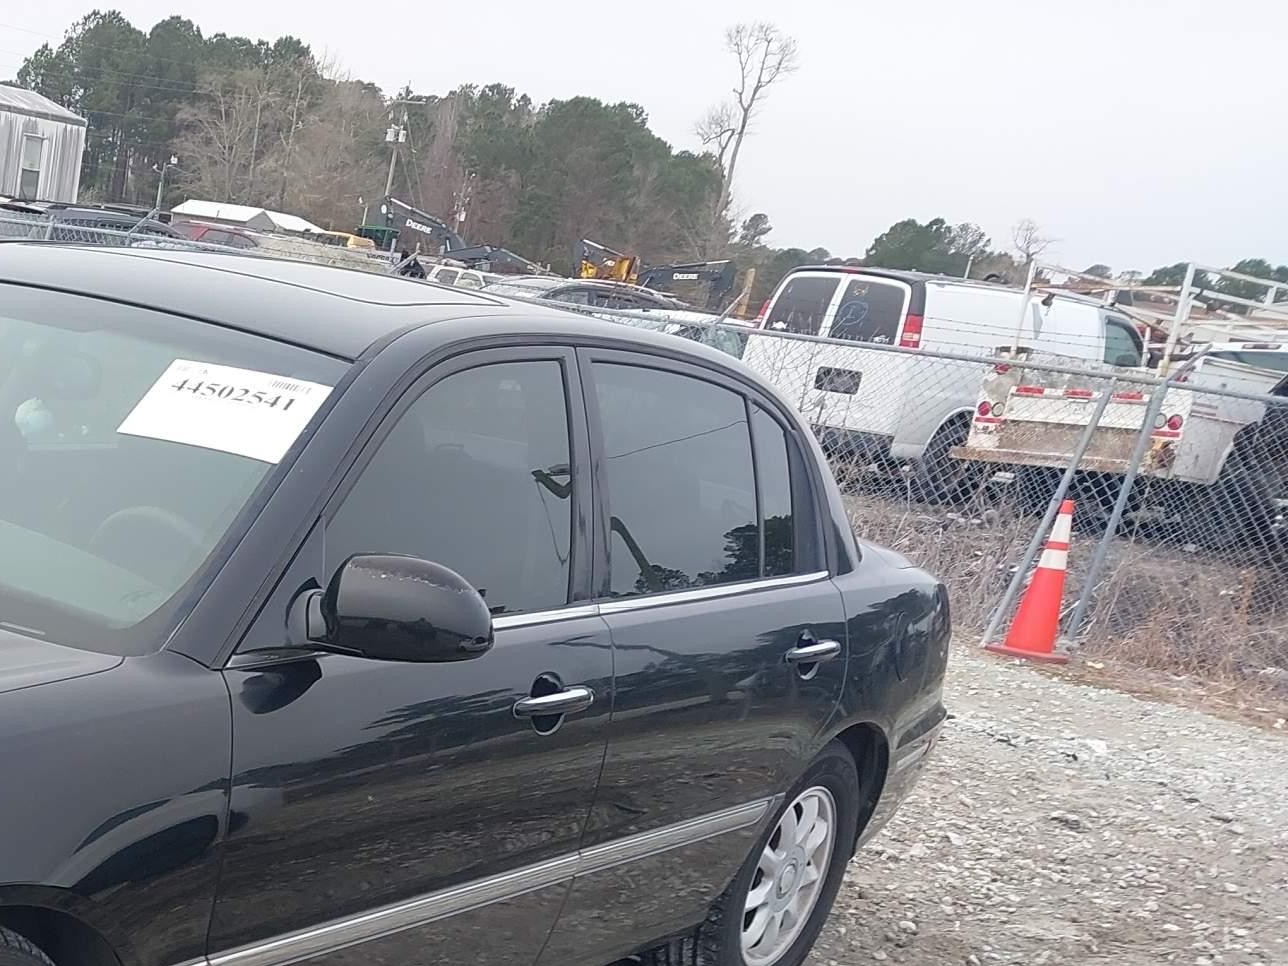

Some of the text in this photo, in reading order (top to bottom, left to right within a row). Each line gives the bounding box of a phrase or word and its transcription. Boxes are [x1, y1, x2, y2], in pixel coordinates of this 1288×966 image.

[405, 218, 433, 234] DEERE
[672, 272, 700, 281] DEERE
[171, 378, 297, 412] 44502541
